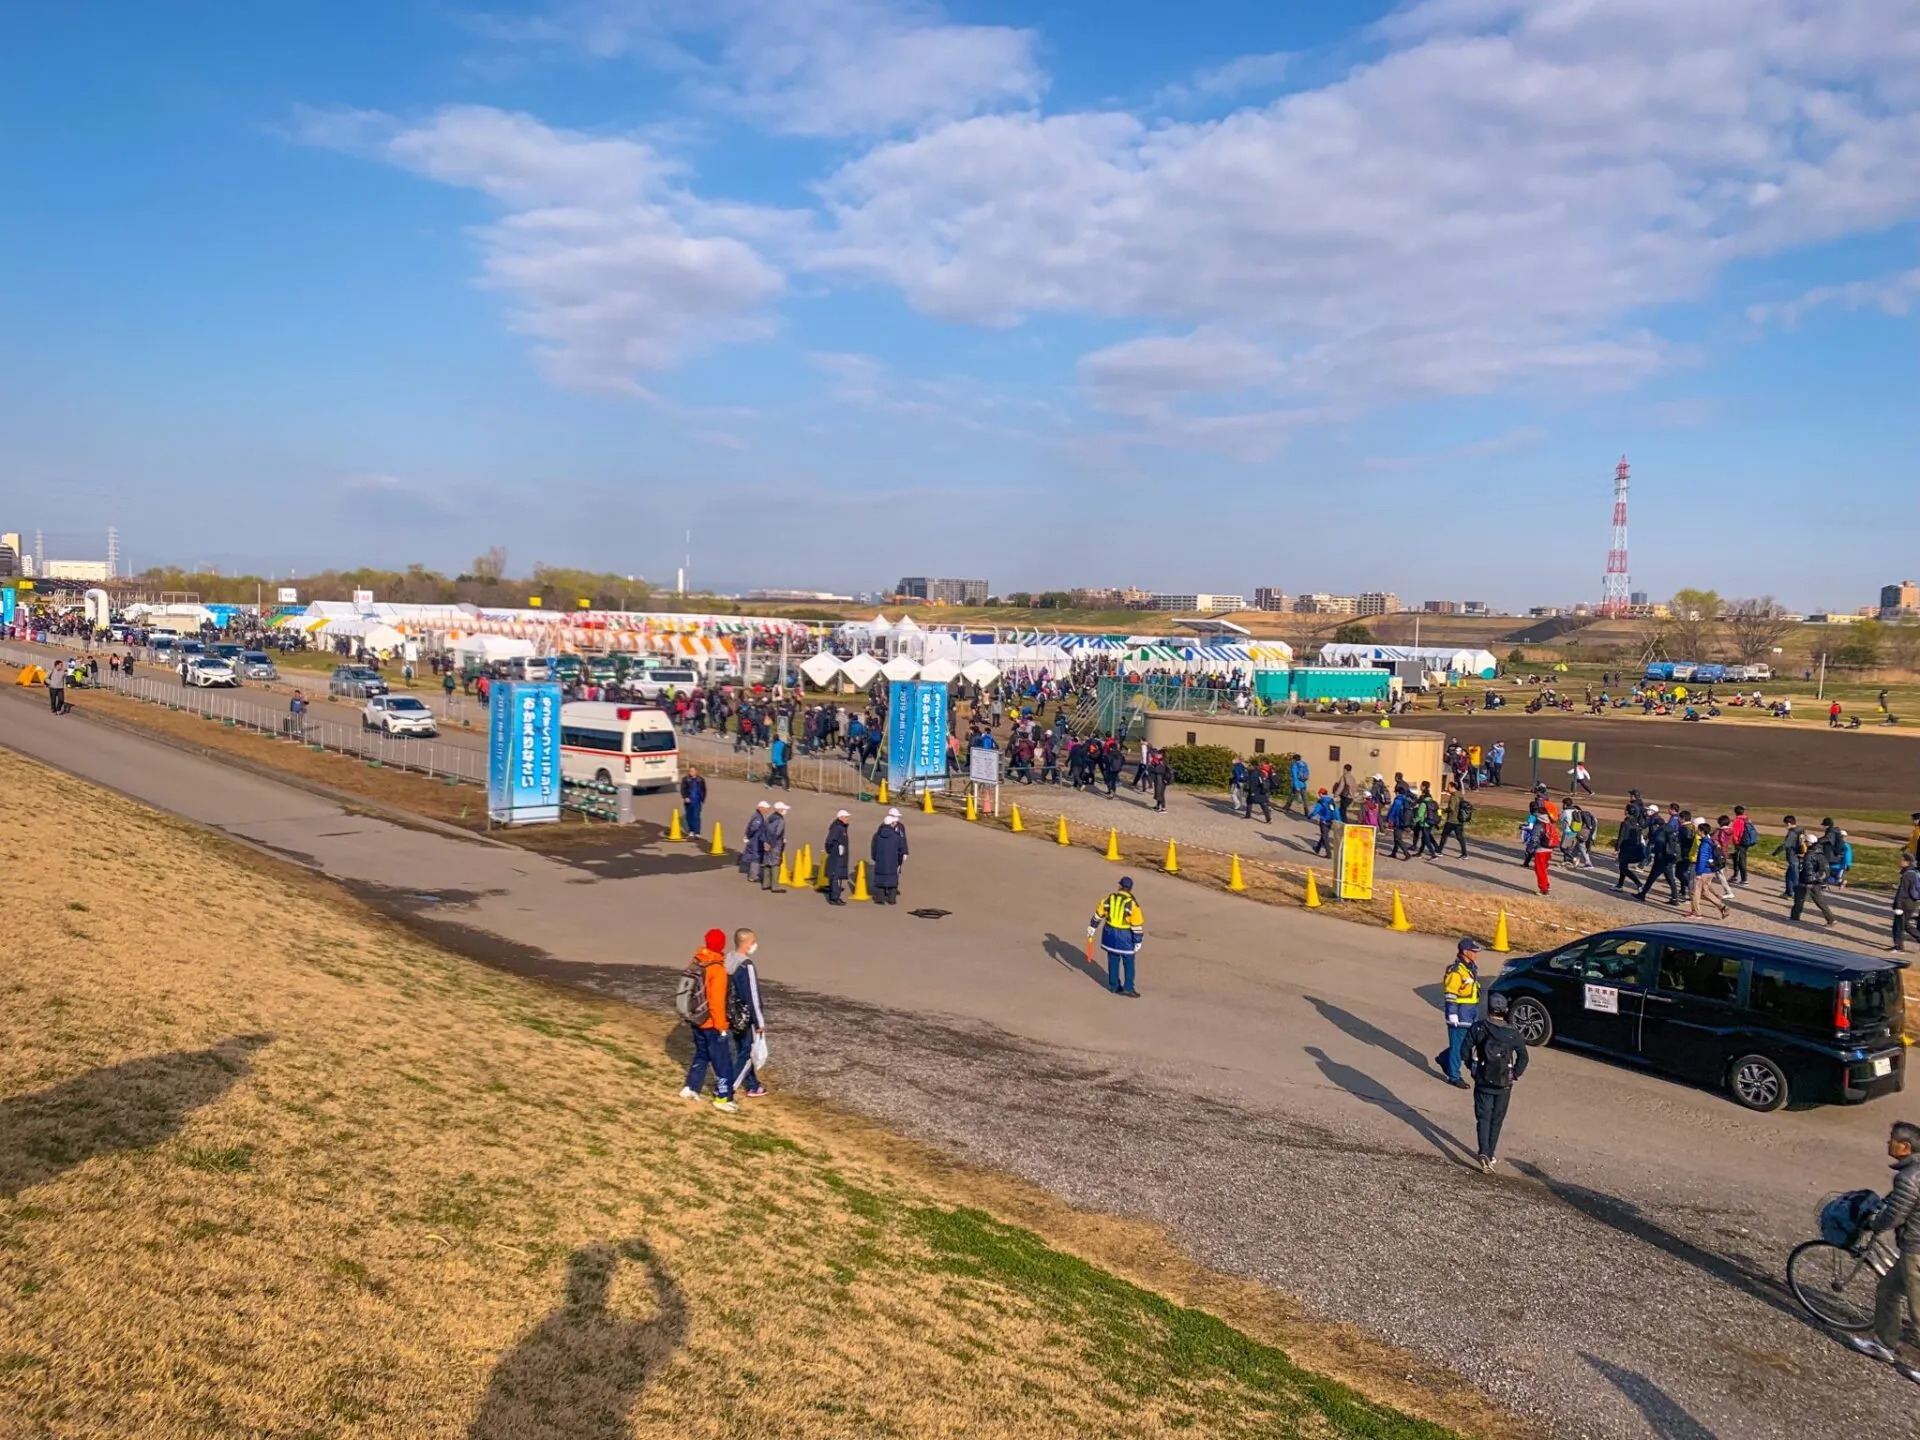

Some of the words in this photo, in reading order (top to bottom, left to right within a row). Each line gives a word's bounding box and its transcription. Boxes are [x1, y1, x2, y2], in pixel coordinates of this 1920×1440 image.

[522, 697, 536, 788] おかえりなさい
[921, 693, 931, 766] おかえりなさい
